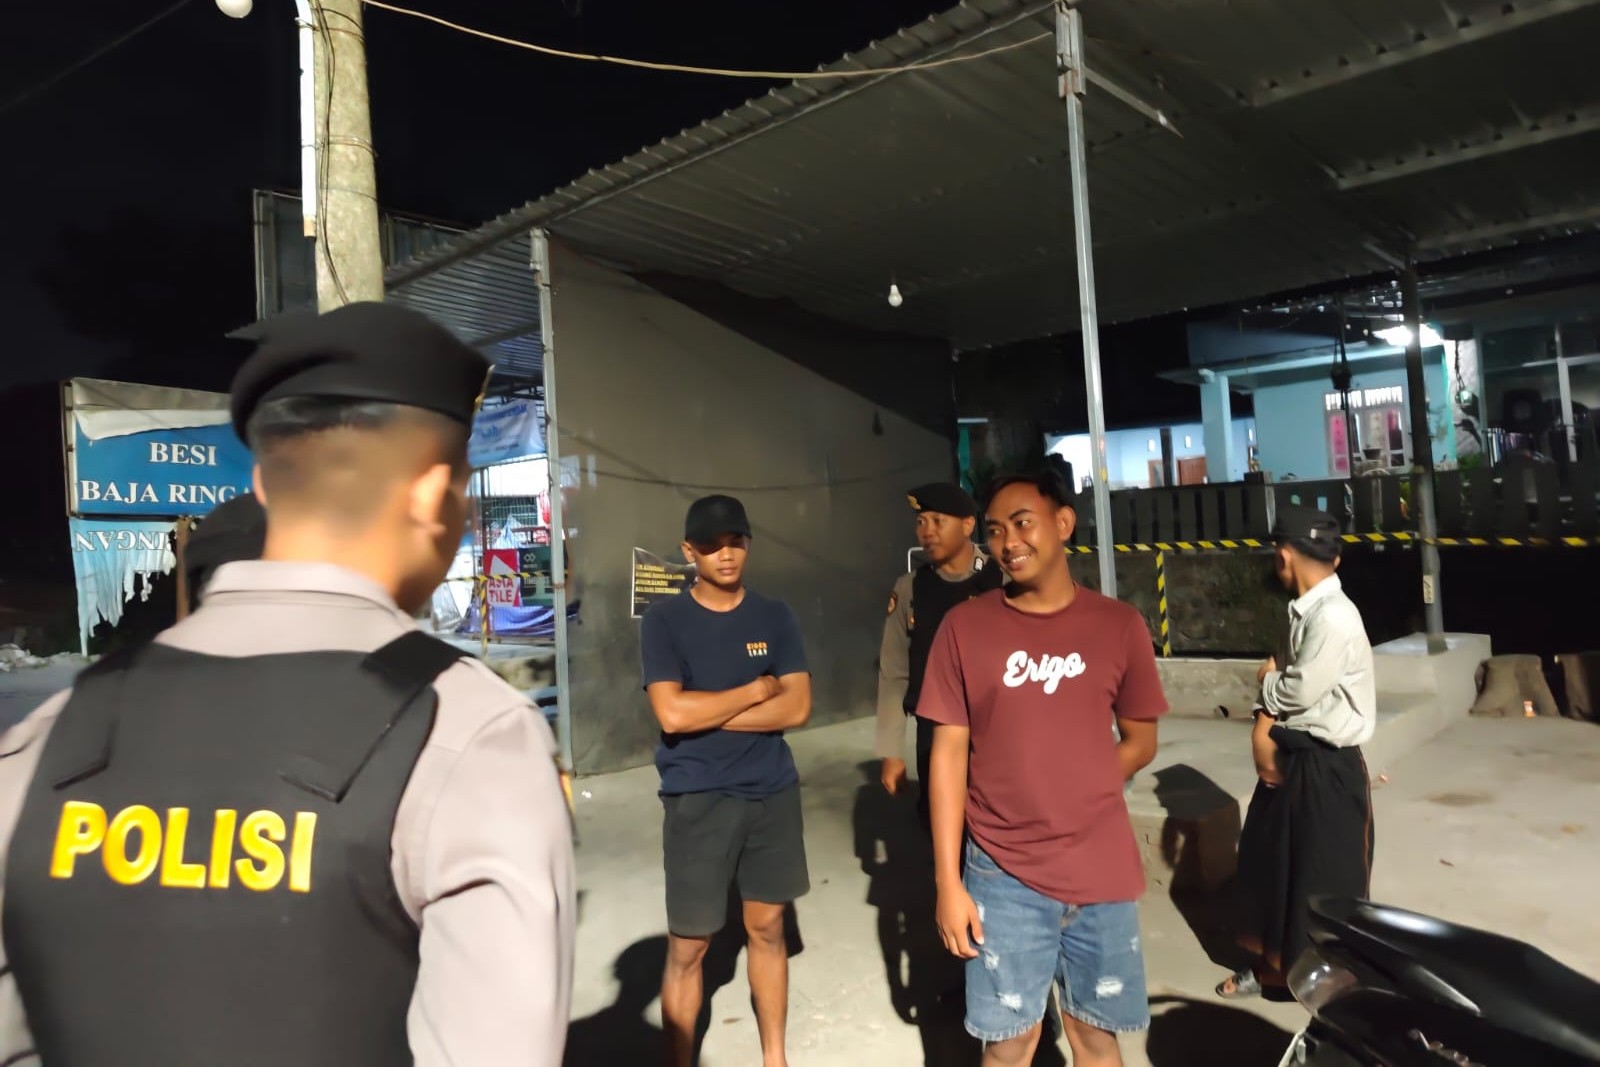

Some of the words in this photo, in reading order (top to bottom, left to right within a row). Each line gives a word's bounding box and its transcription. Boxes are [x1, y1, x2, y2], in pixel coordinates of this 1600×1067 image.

[149, 442, 216, 466] BESI
[80, 480, 159, 504] BAJA
[168, 484, 250, 504] RING
[76, 530, 170, 552] INGAN
[488, 590, 513, 603] TILE
[1003, 650, 1087, 695] Erigo
[50, 800, 318, 893] POLISI
